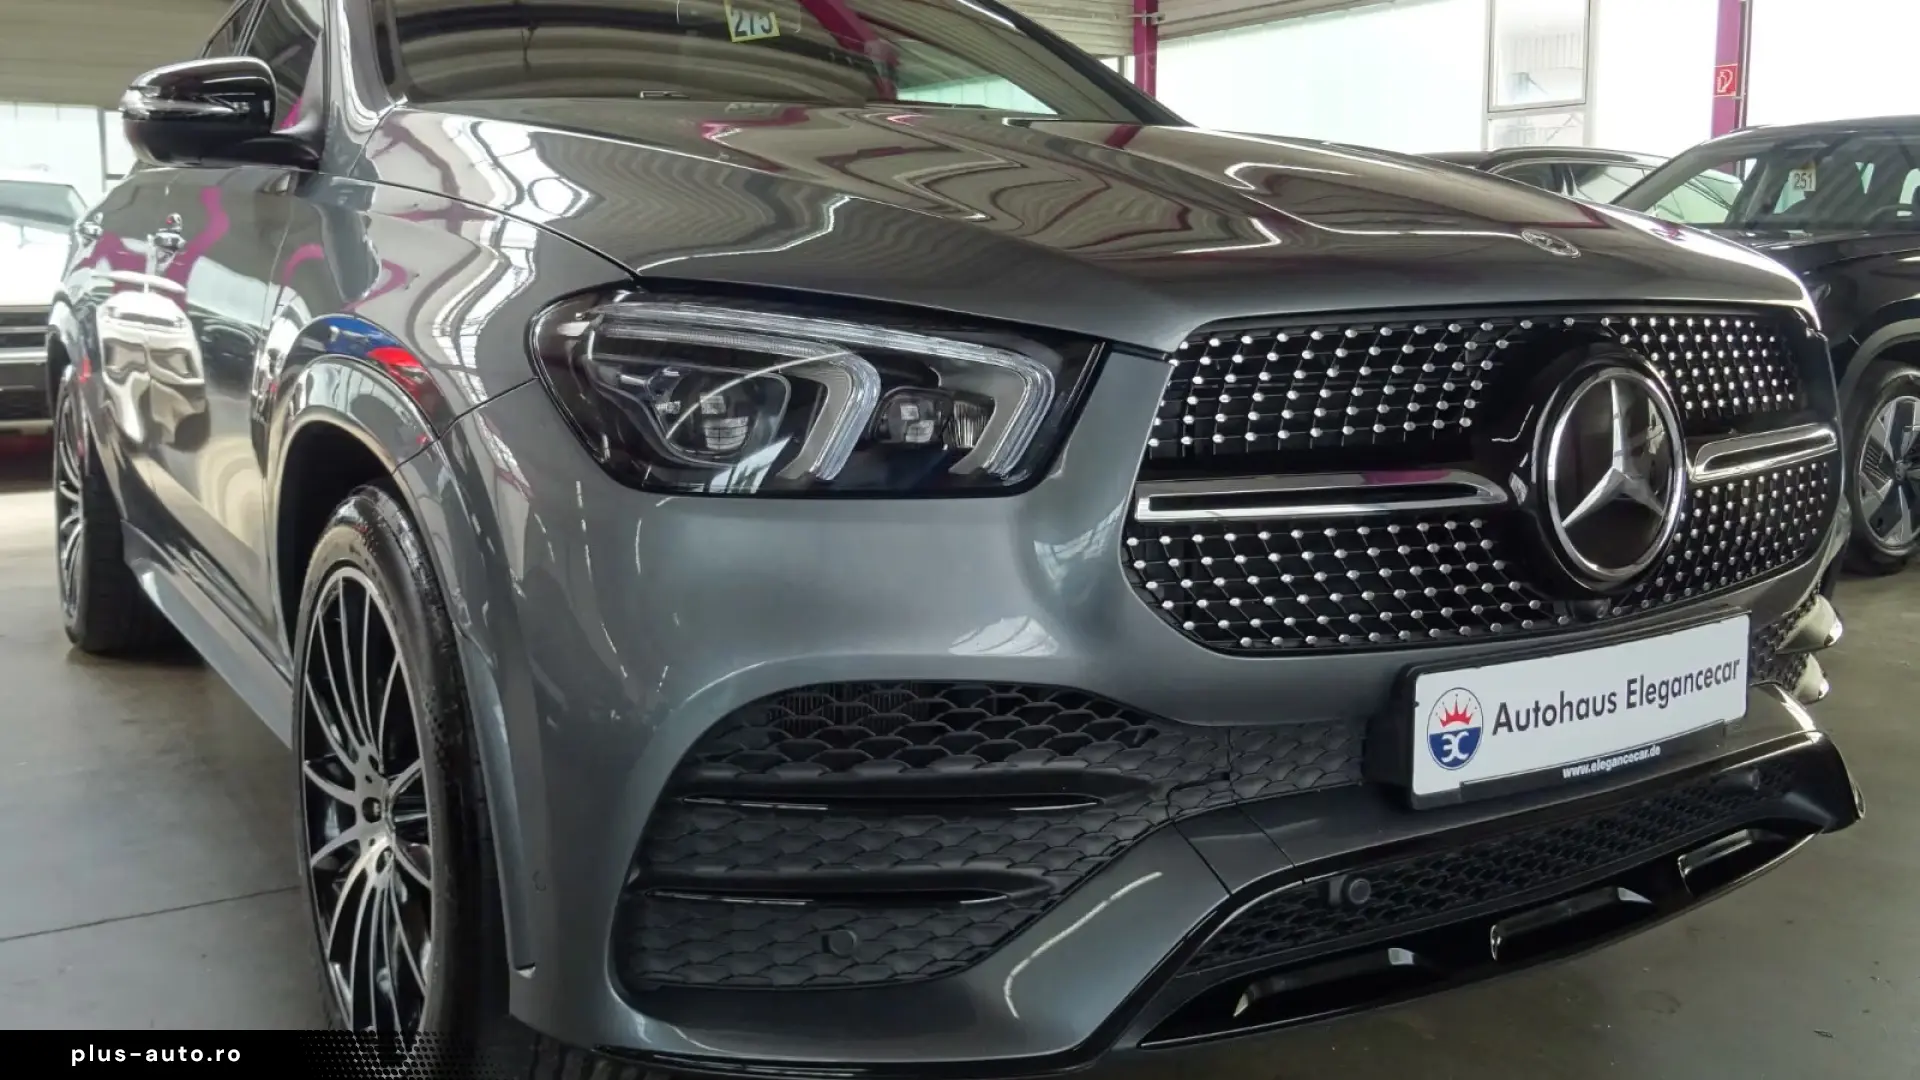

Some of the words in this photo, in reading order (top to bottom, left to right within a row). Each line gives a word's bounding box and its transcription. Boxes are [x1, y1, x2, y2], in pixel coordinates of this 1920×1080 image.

[1793, 172, 1813, 189] 251
[1492, 690, 1618, 736] Autohaus
[1626, 658, 1741, 709] Elegancecar
[1562, 745, 1661, 778] www.elegancecar.de
